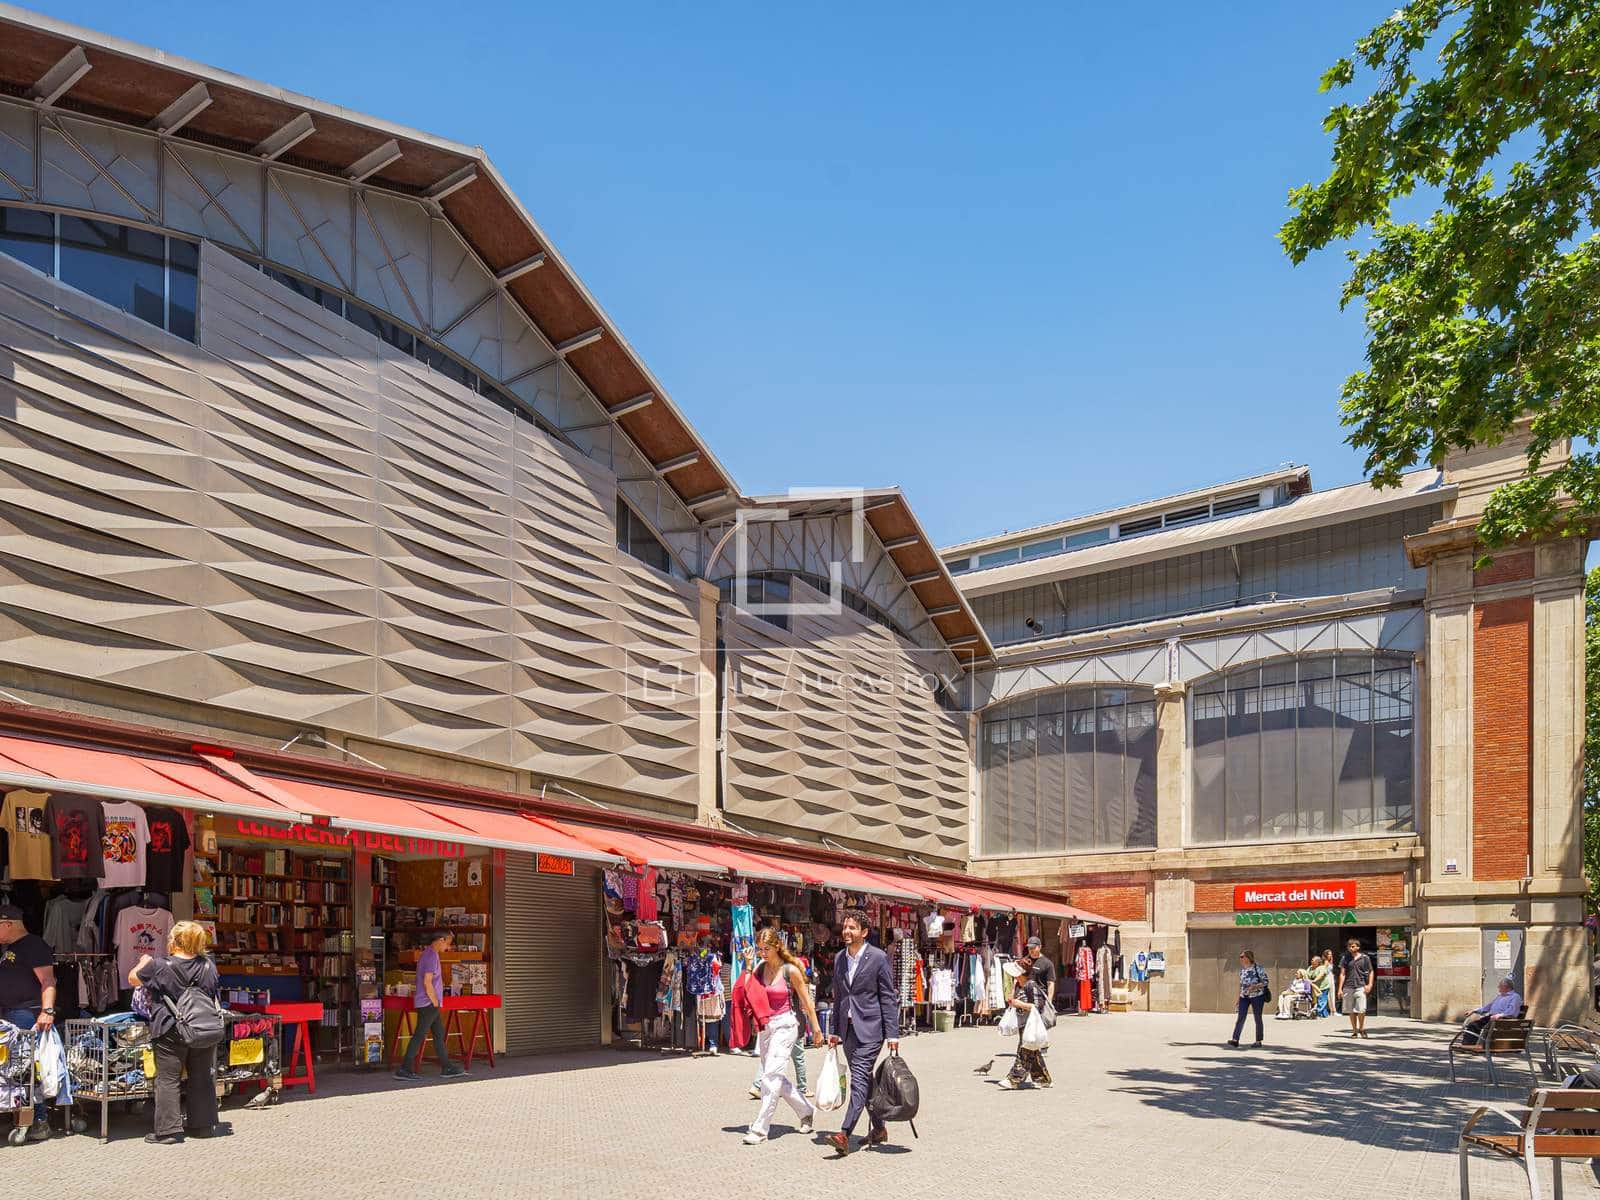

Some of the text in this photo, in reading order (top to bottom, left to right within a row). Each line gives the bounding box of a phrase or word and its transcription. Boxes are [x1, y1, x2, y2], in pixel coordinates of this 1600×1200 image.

[1244, 888, 1345, 902] Mercat del Ninot
[1235, 911, 1358, 926] MERCADONA
